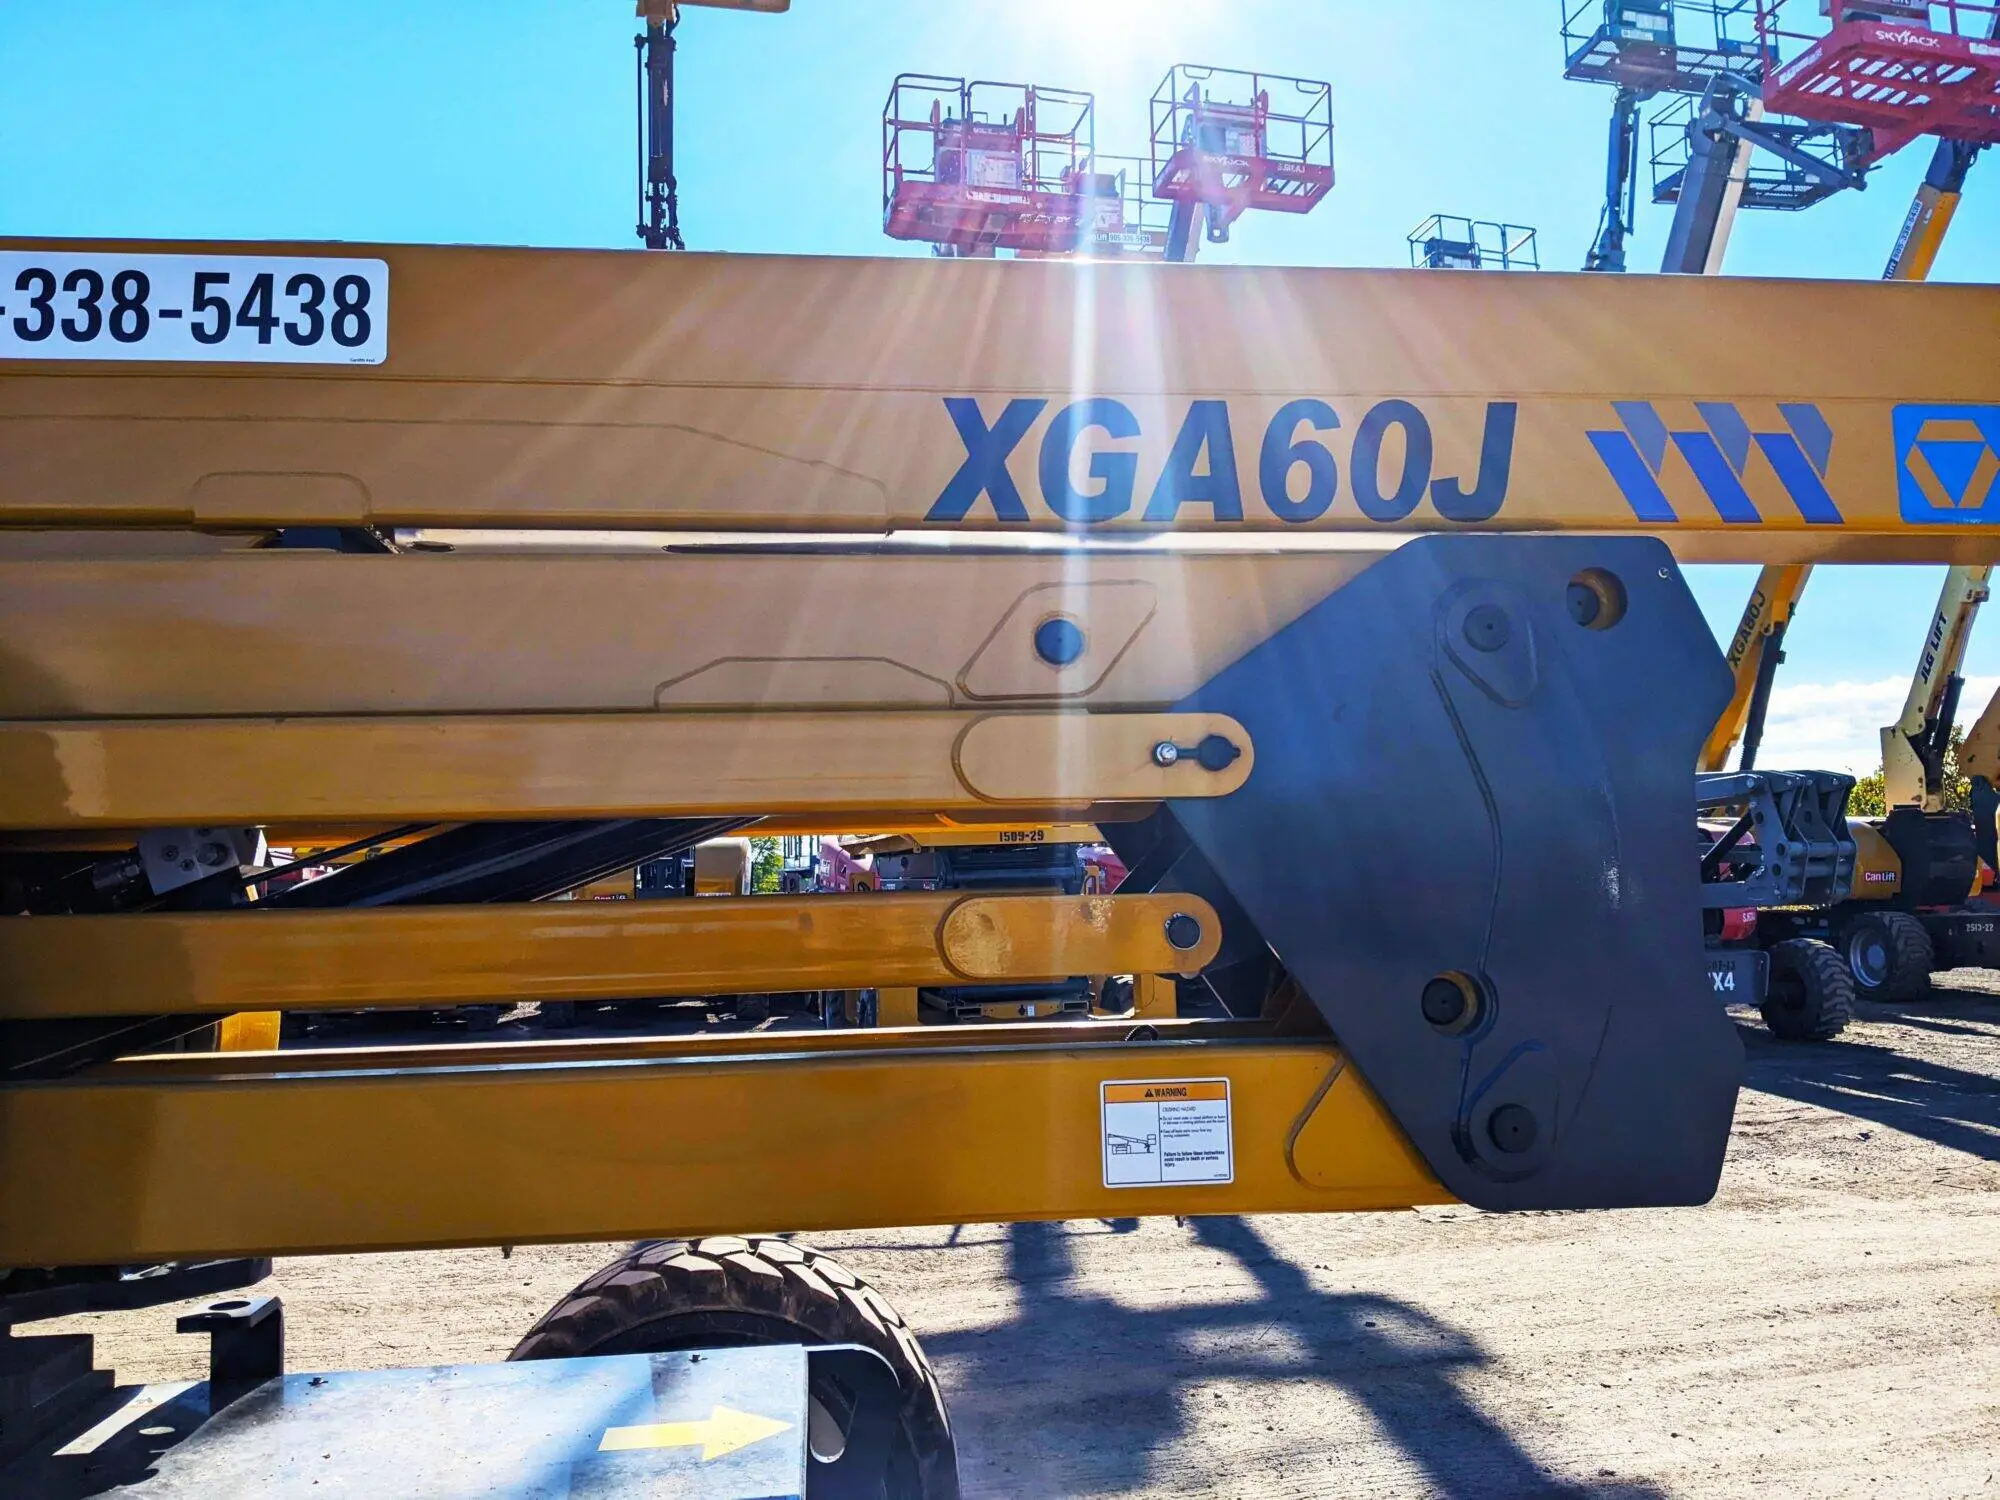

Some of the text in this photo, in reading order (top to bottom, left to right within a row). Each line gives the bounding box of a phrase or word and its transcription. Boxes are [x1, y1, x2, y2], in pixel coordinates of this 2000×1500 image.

[0, 268, 372, 348] 338-5438
[923, 397, 1517, 524] XGA60J
[1920, 611, 1948, 685] JLG LIFT
[1000, 830, 1045, 842] 1509-29
[1707, 971, 1736, 992] X4
[1154, 1087, 1187, 1098] WARNING
